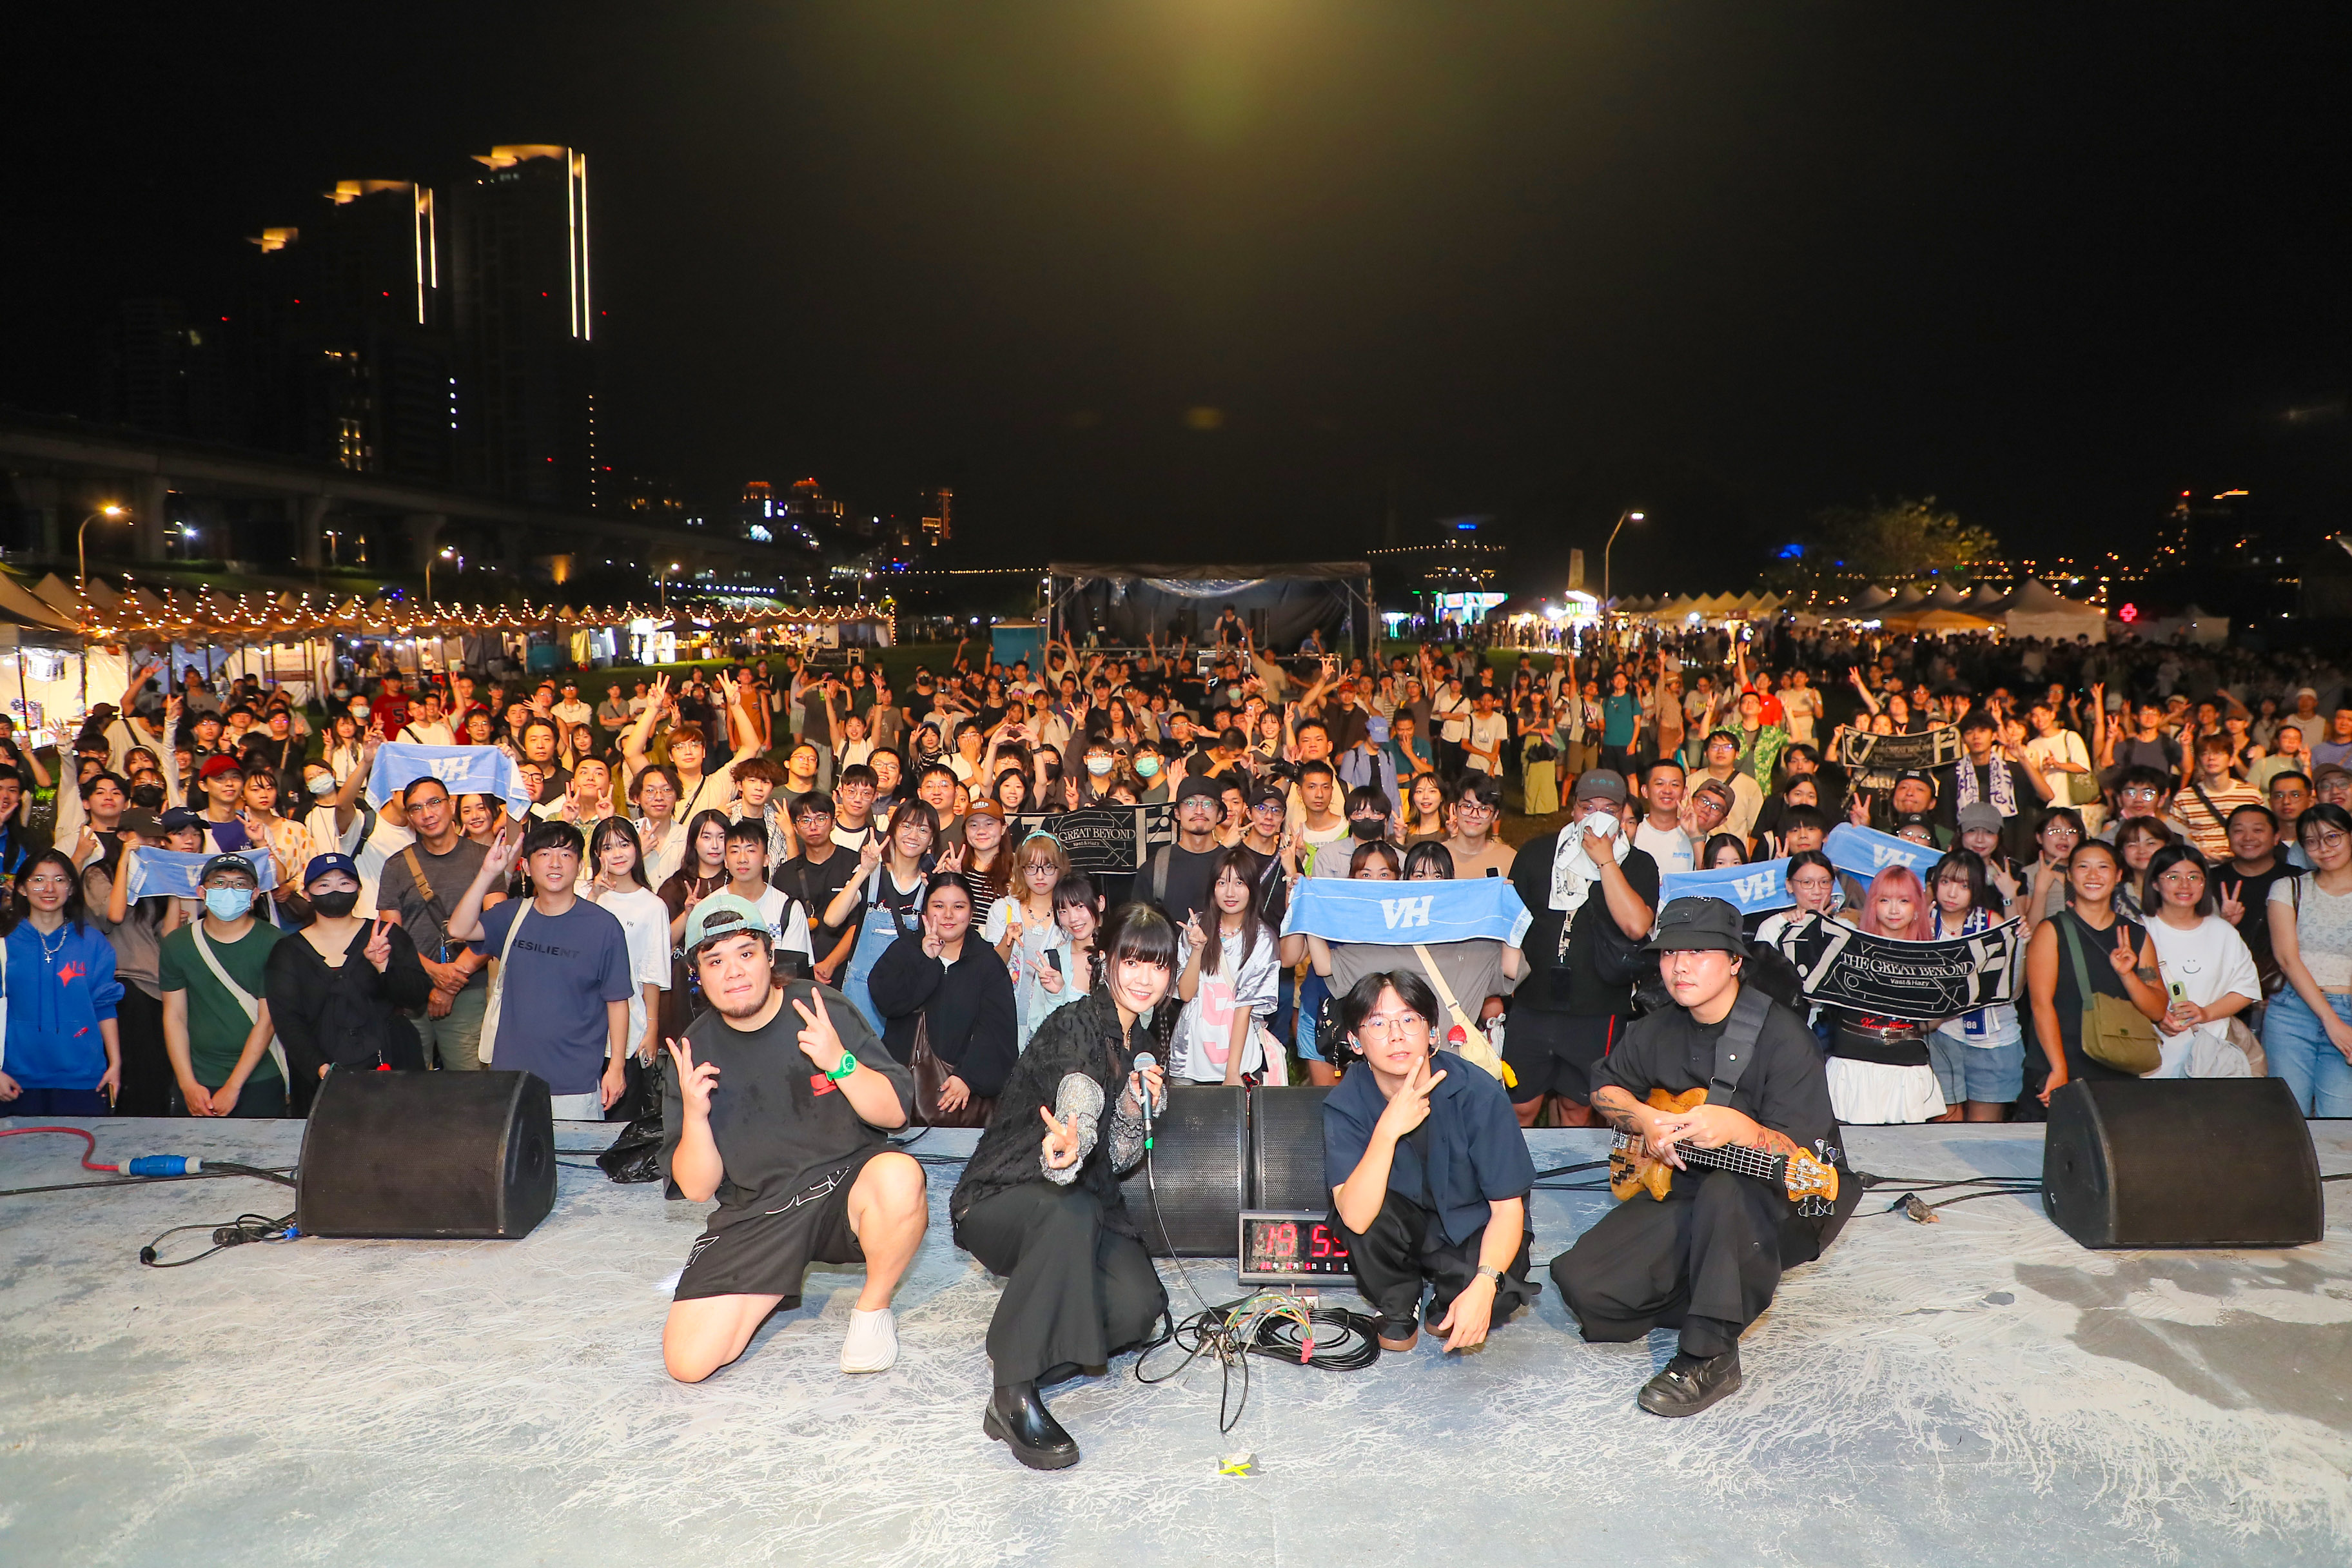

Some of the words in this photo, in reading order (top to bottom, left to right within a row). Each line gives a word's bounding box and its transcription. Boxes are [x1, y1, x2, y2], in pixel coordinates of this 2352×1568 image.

[392, 707, 406, 725] 5
[428, 756, 473, 781] VH
[1058, 828, 1092, 842] GREAT
[1093, 828, 1136, 839] BEYOND
[1872, 843, 1917, 868] VH
[186, 865, 204, 887] V
[1731, 870, 1778, 904] VH
[1380, 895, 1435, 930] VH
[513, 938, 580, 959] RESILIENT
[1840, 952, 1870, 970] THE
[1870, 959, 1917, 975] GREAT
[1919, 961, 1975, 976] BEYOND
